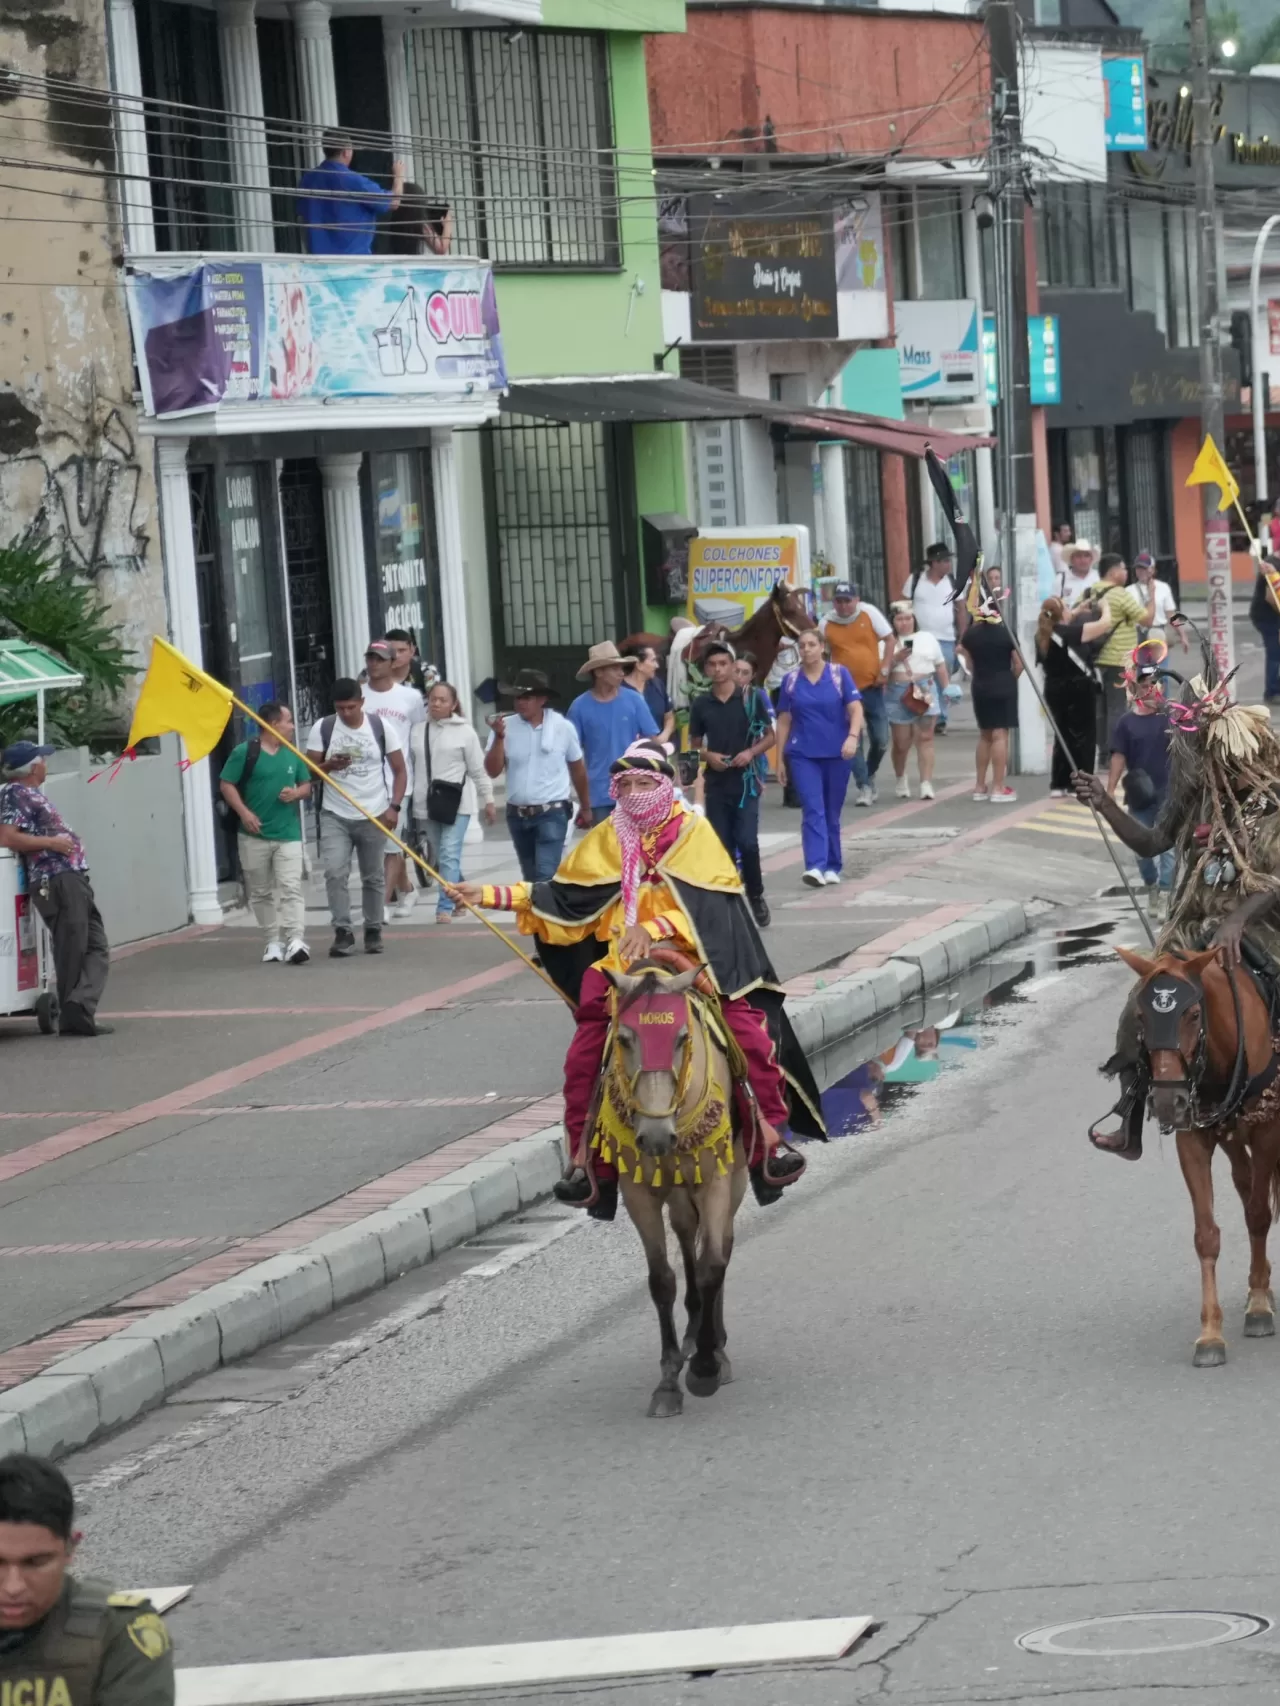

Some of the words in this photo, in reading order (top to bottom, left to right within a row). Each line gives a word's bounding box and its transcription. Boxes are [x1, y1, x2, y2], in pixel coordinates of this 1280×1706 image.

[903, 344, 932, 366] Mass
[703, 546, 780, 562] COLCHONES
[692, 567, 790, 594] SUPERCONFORT
[638, 1011, 675, 1025] MOROS
